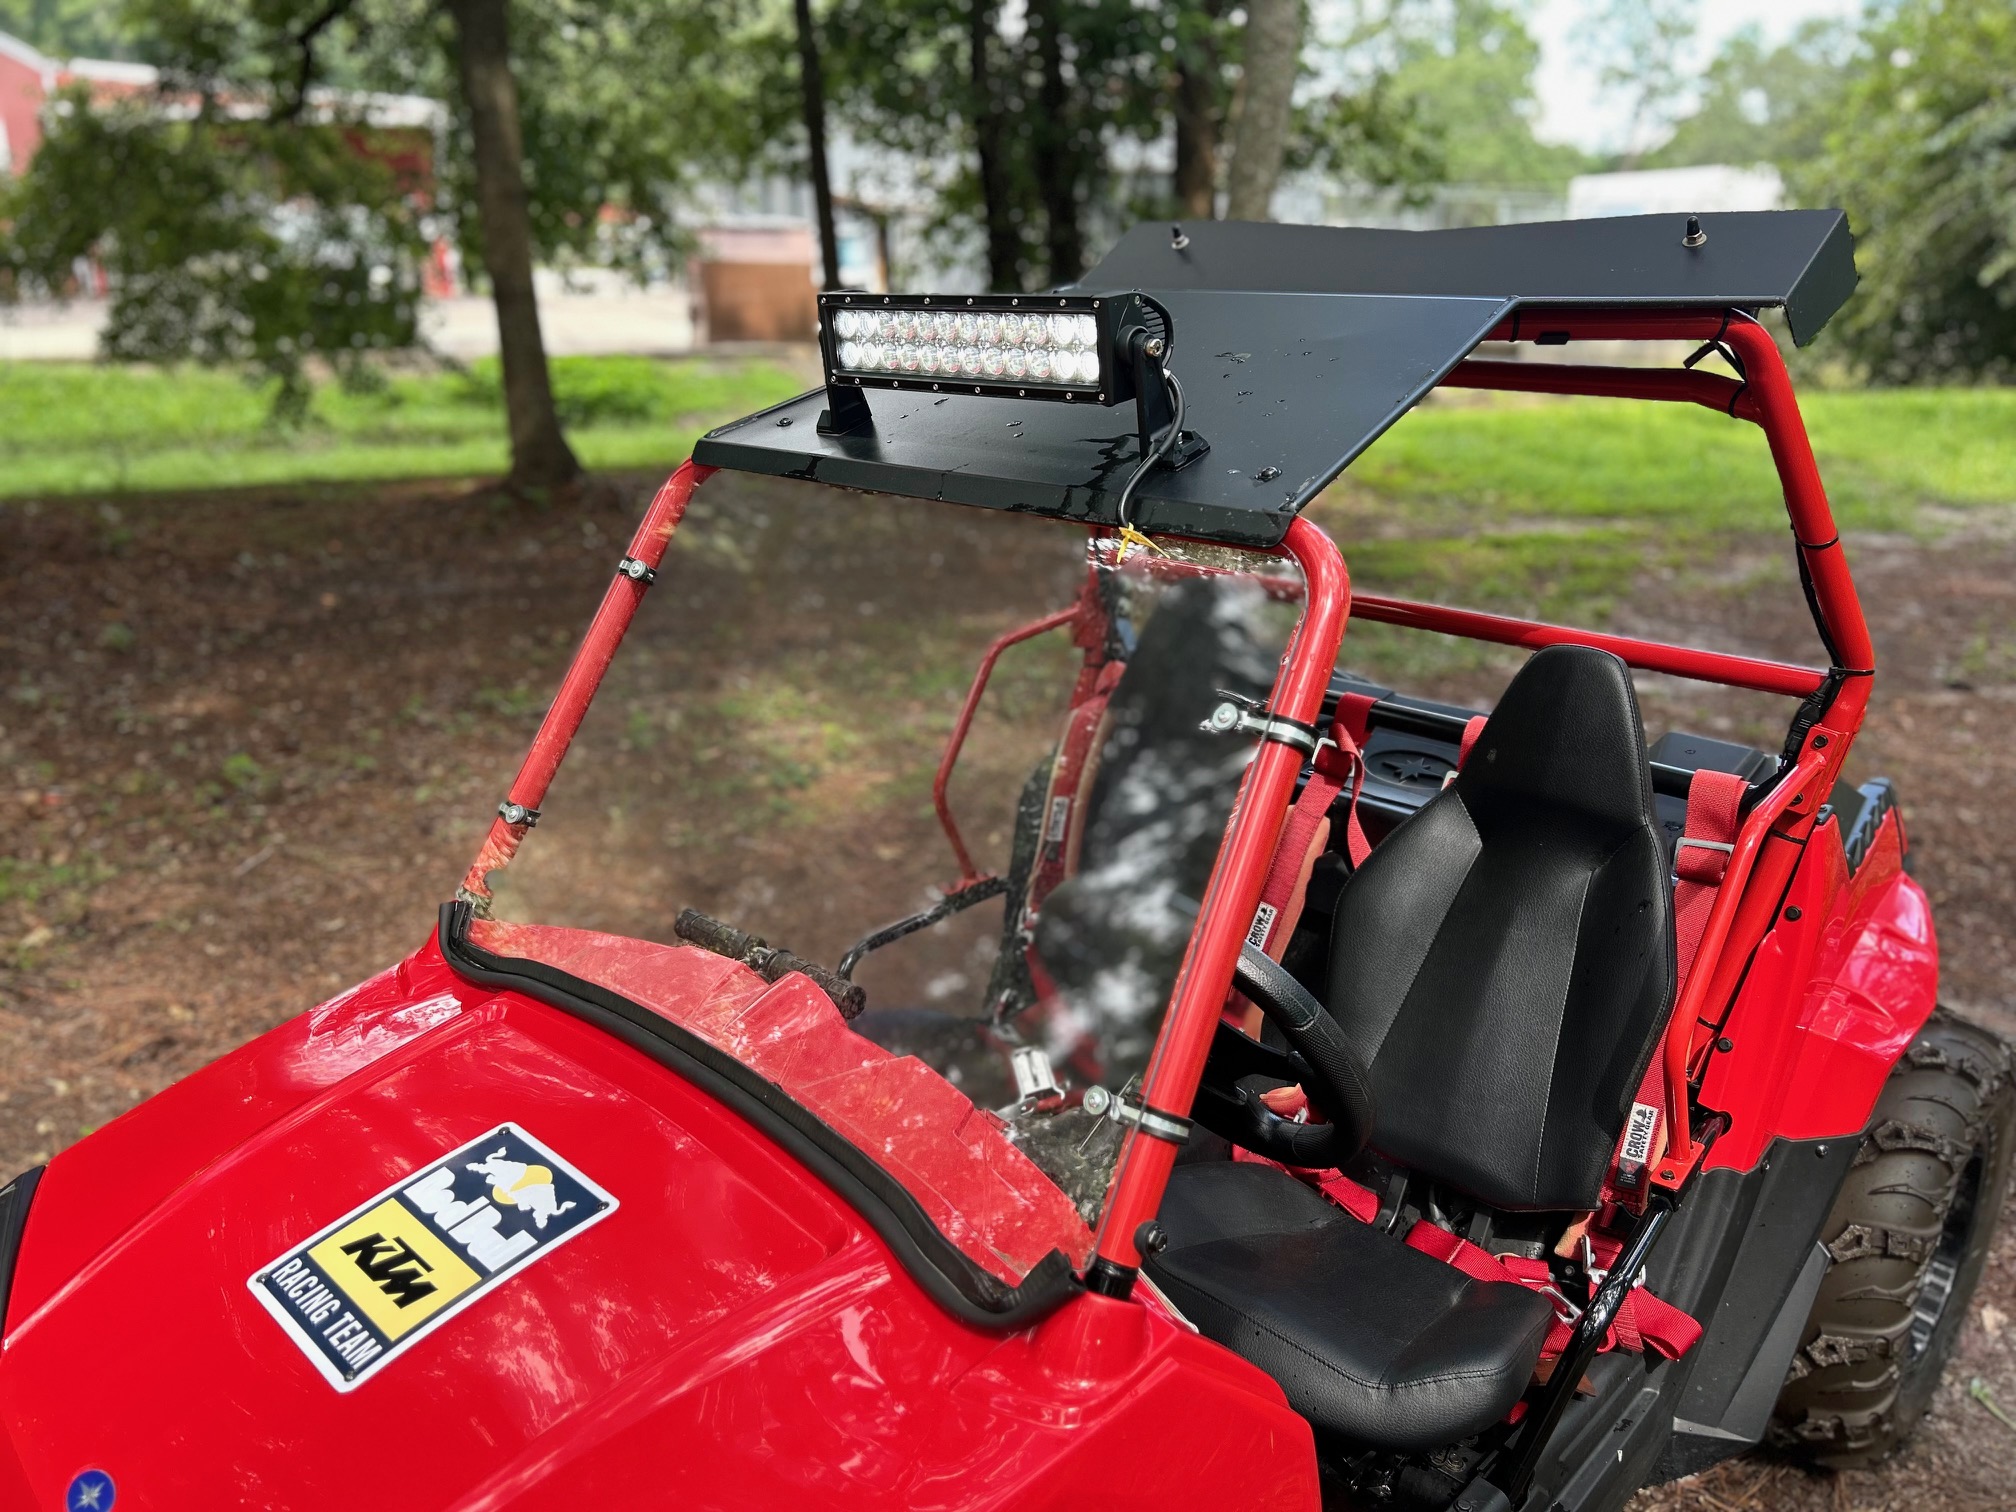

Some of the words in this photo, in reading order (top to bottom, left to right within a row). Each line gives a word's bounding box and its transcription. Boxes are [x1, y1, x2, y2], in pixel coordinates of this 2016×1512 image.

[1248, 915, 1265, 945] CROW
[1626, 1120, 1645, 1158] CROW
[1637, 1130, 1649, 1159] SAFETY
[1644, 1110, 1654, 1130] GEAR
[340, 1232, 439, 1310] KTM
[271, 1257, 342, 1325] RACING
[322, 1311, 383, 1370] TEAM
